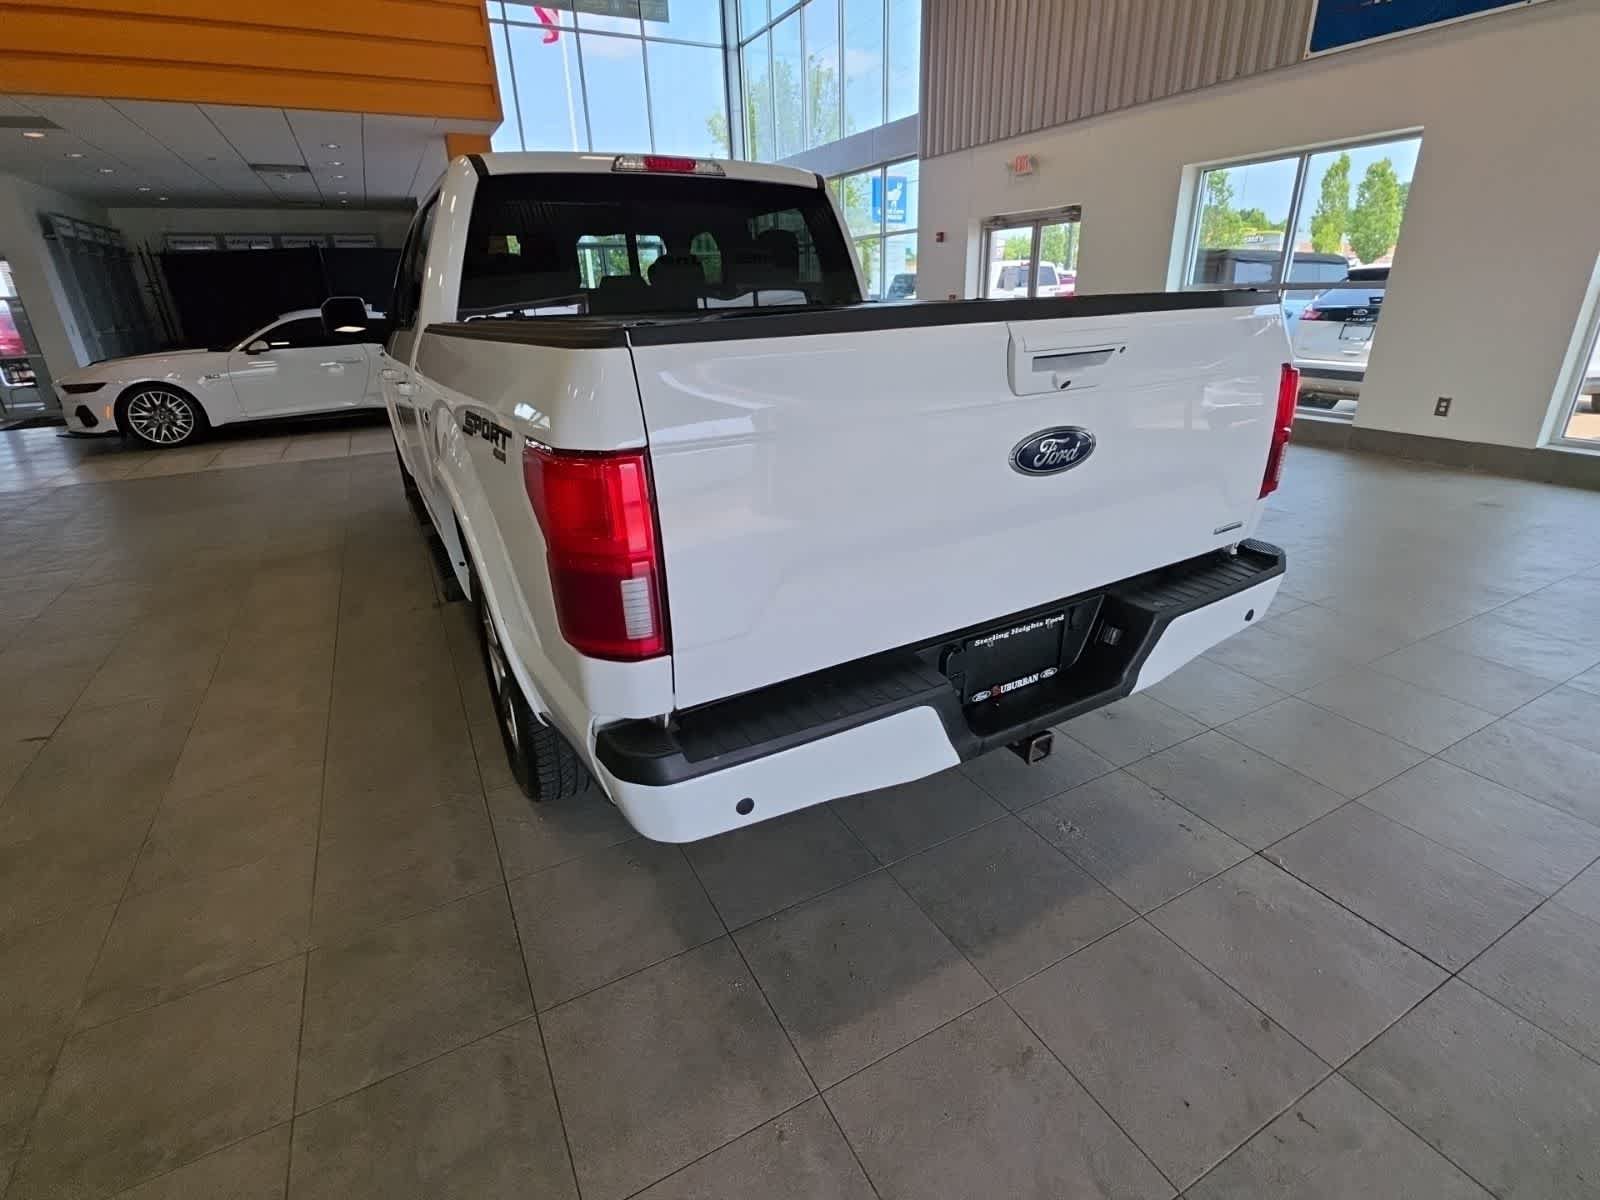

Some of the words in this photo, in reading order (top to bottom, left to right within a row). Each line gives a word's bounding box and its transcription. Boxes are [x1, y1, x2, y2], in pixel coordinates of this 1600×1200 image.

[463, 410, 512, 450] SPORT
[1033, 437, 1080, 467] Ford
[974, 632, 1009, 647] Sterling
[1011, 622, 1043, 635] Heights
[1045, 614, 1065, 625] Ford
[992, 673, 1040, 696] SUBURBAN
